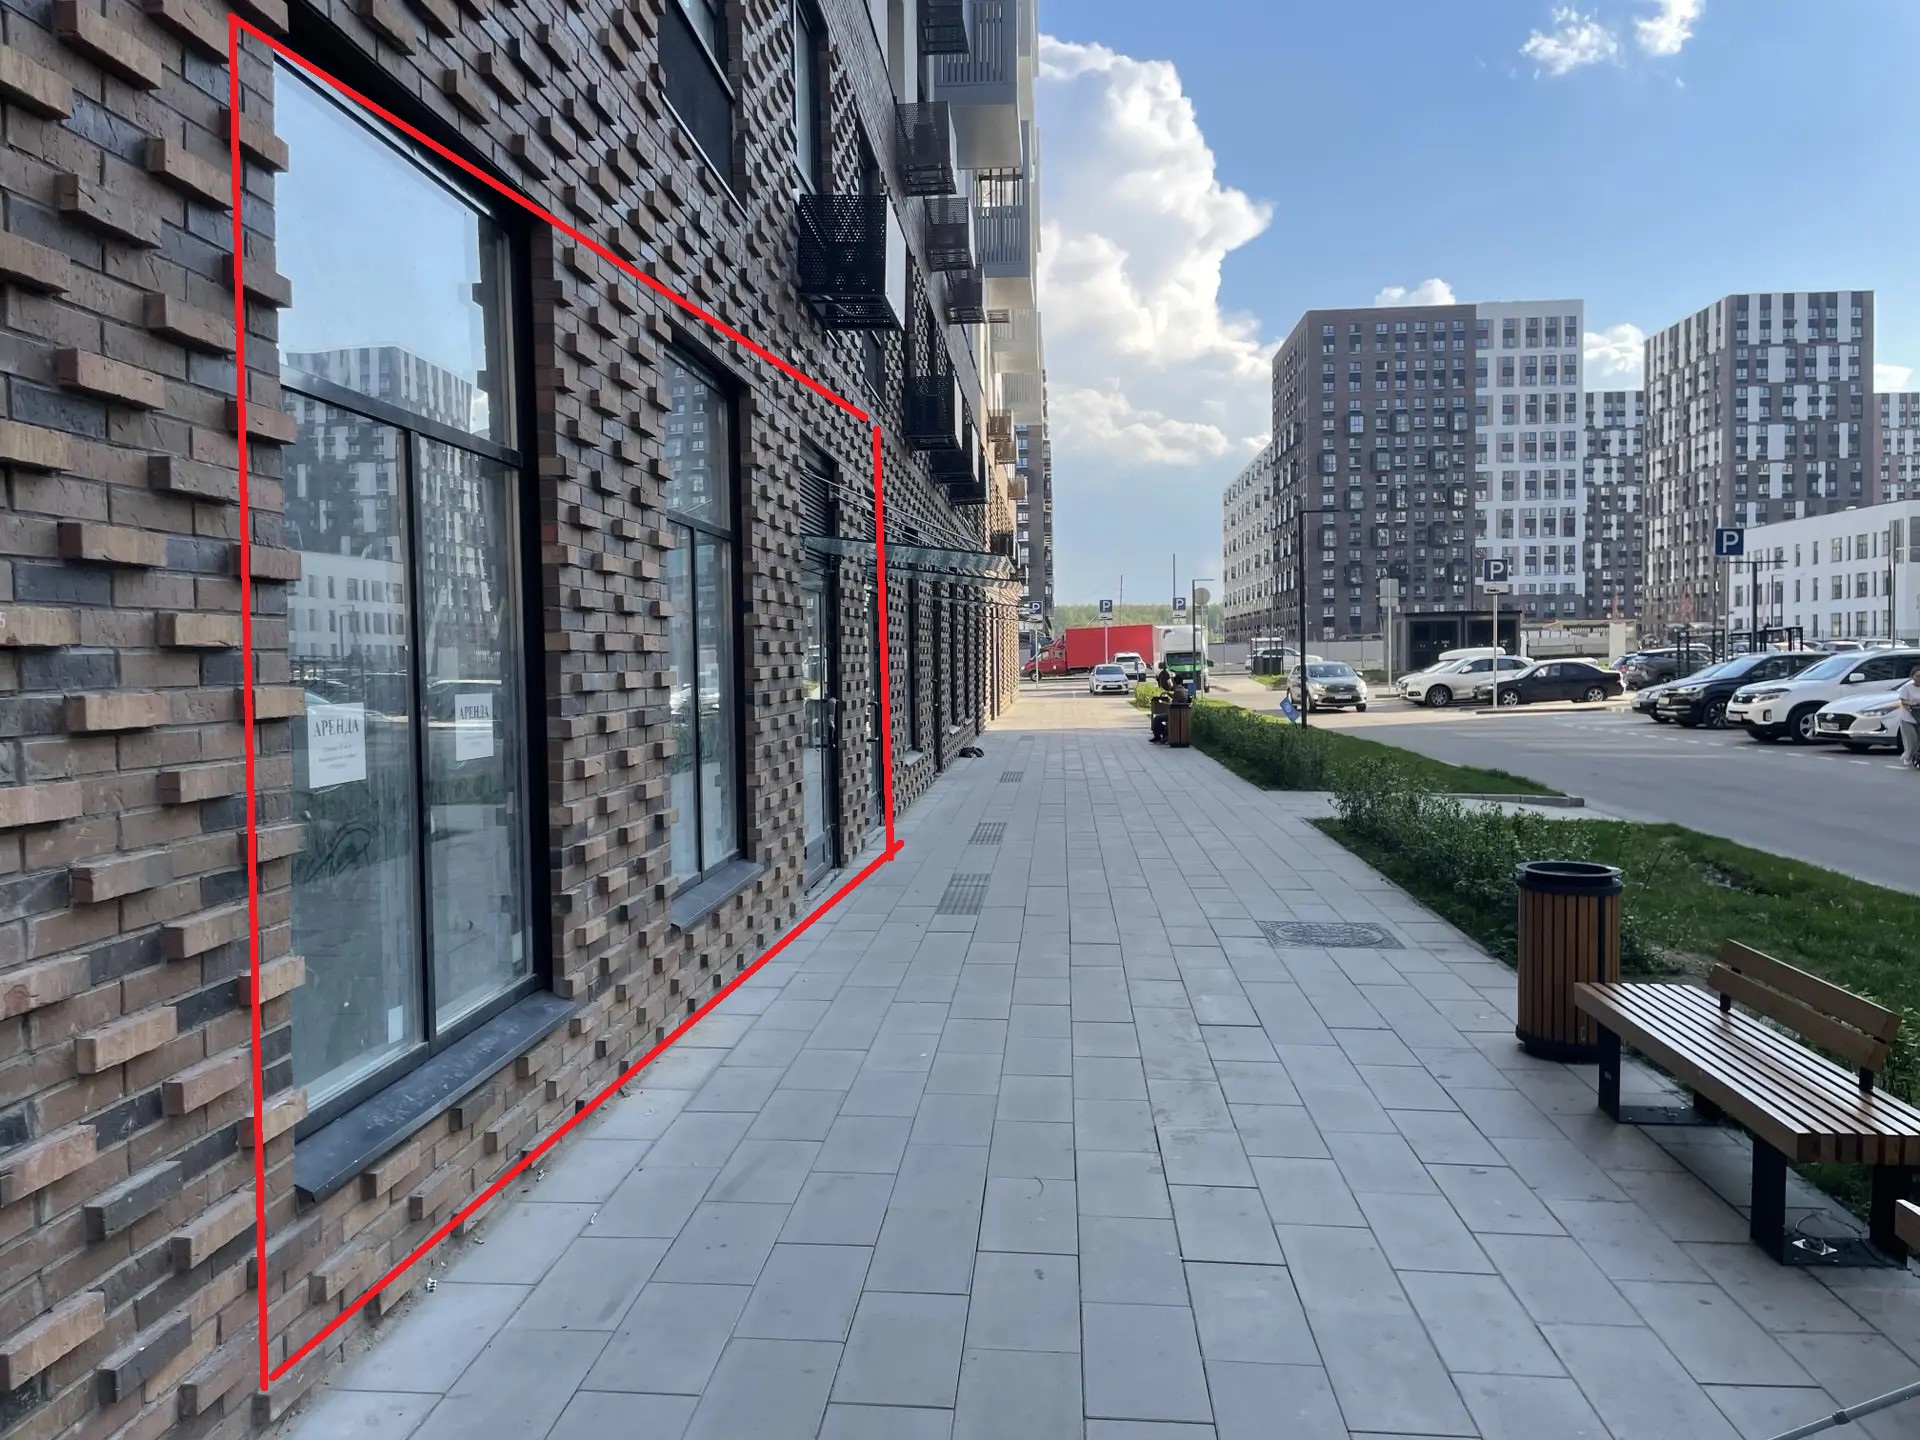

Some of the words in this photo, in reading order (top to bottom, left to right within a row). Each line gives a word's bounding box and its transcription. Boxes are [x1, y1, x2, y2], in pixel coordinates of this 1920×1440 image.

[1723, 531, 1739, 553] P
[1490, 561, 1504, 580] P
[1102, 601, 1111, 611] P
[1176, 599, 1185, 610] P
[459, 705, 489, 720] АРЕНДА
[314, 717, 359, 737] АРЕНДА
